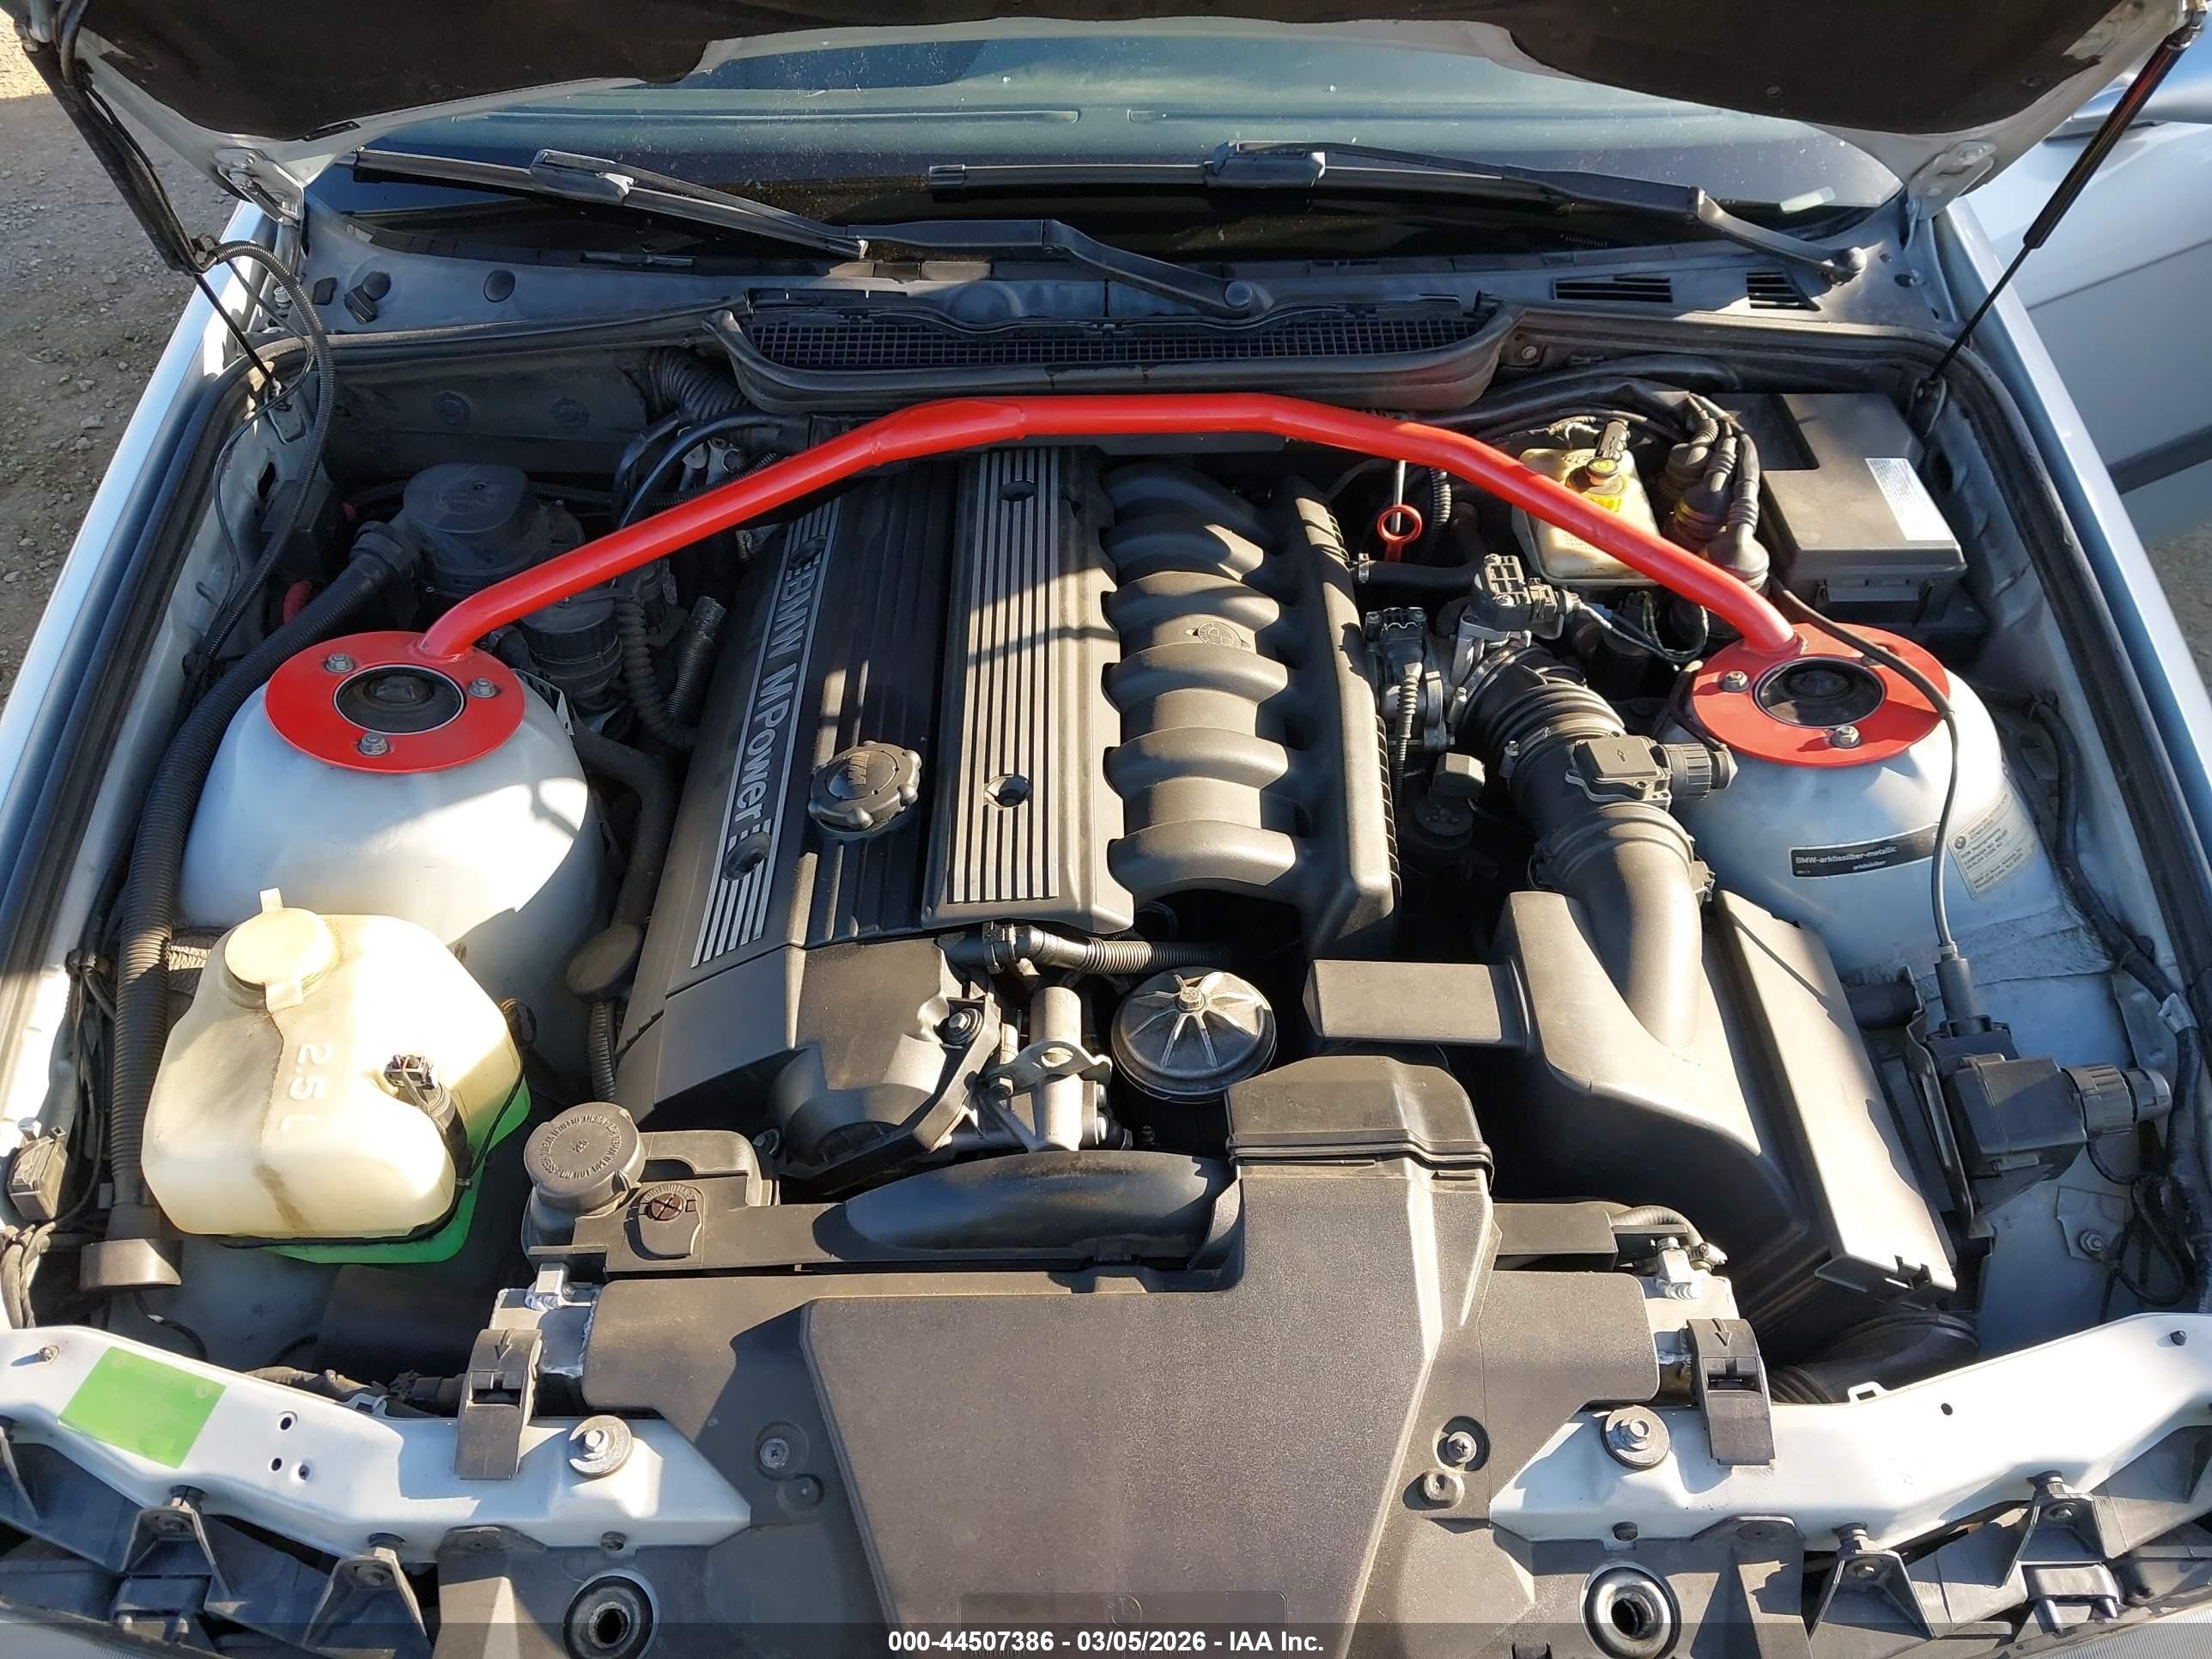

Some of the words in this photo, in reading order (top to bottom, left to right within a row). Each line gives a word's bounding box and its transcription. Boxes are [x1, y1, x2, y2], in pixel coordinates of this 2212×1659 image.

[769, 569, 816, 659] BMW
[734, 662, 798, 823] MPower
[289, 1042, 331, 1100] 2.5
